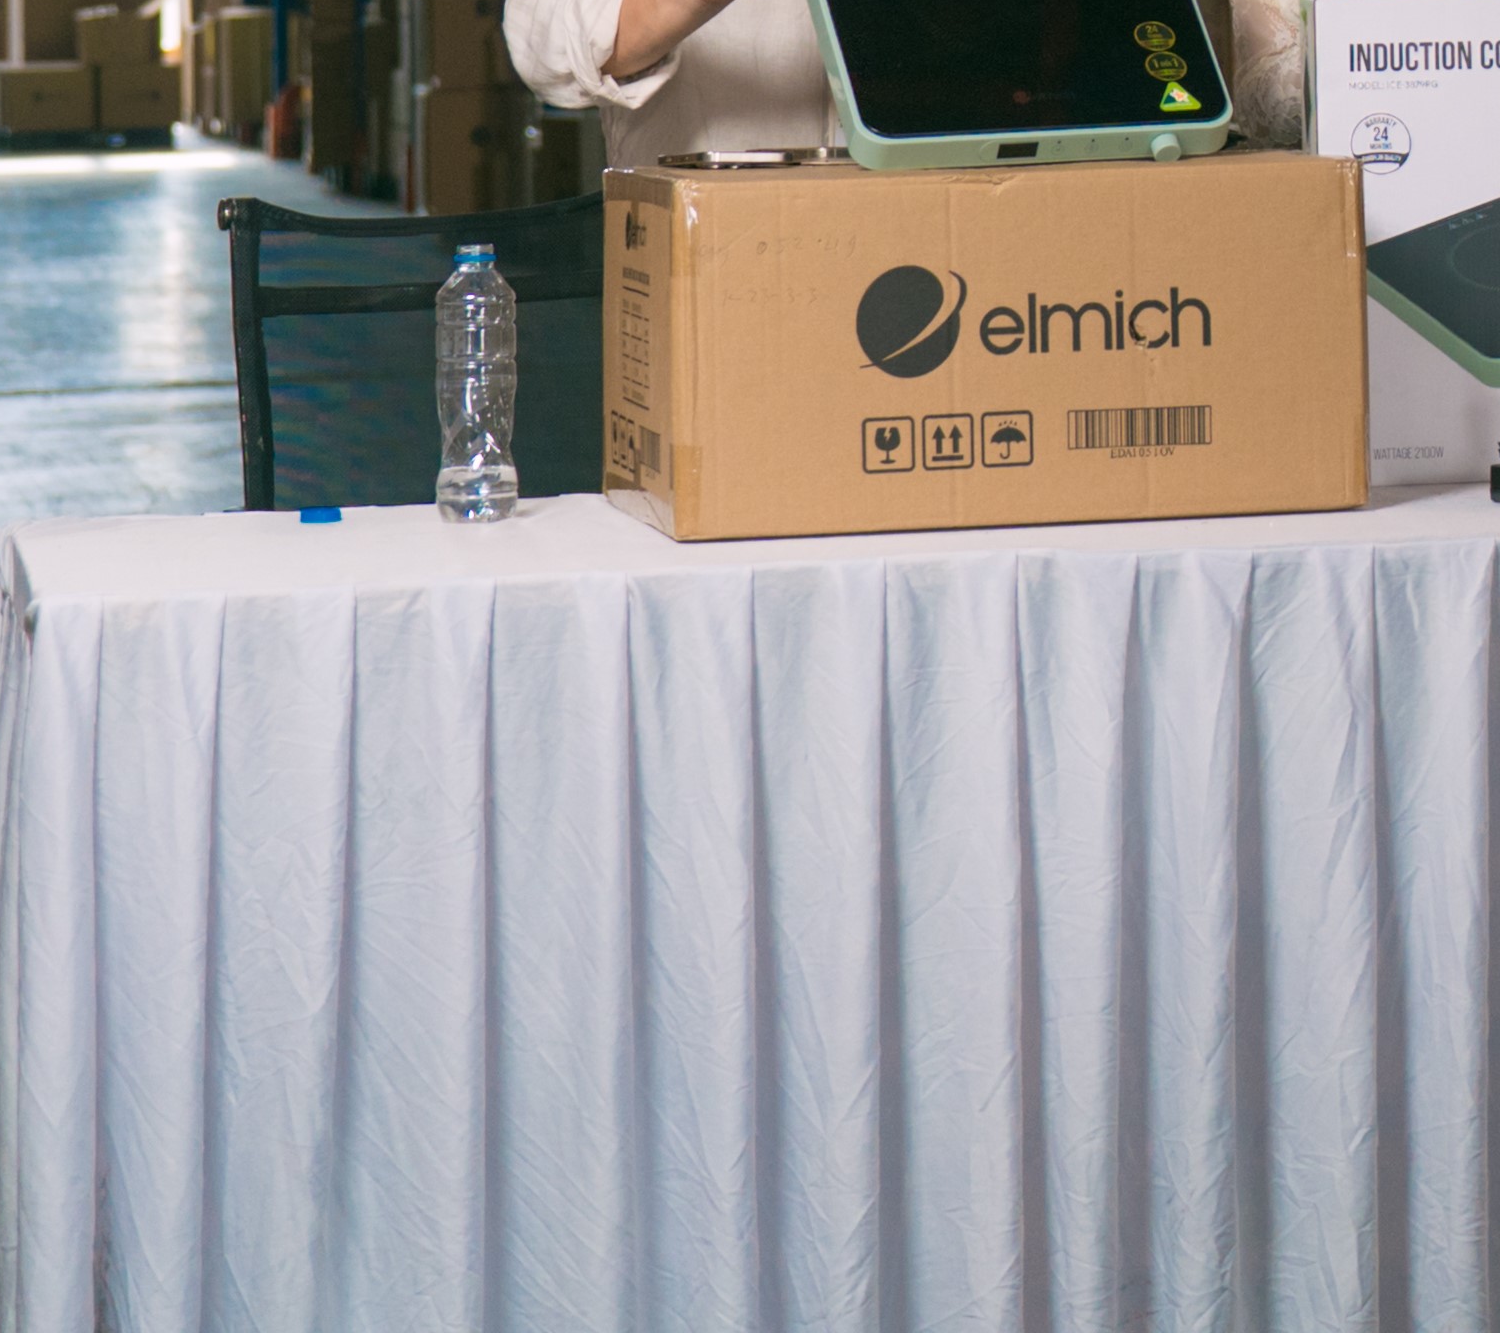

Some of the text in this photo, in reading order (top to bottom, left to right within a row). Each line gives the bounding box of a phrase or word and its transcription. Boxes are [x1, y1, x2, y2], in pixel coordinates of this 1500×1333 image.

[1349, 40, 1473, 72] INDUCTION
[1364, 117, 1397, 129] WARRANTY
[1373, 126, 1389, 142] 24
[979, 287, 1212, 356] elmich
[1373, 445, 1444, 460] WATTAGE 2100W
